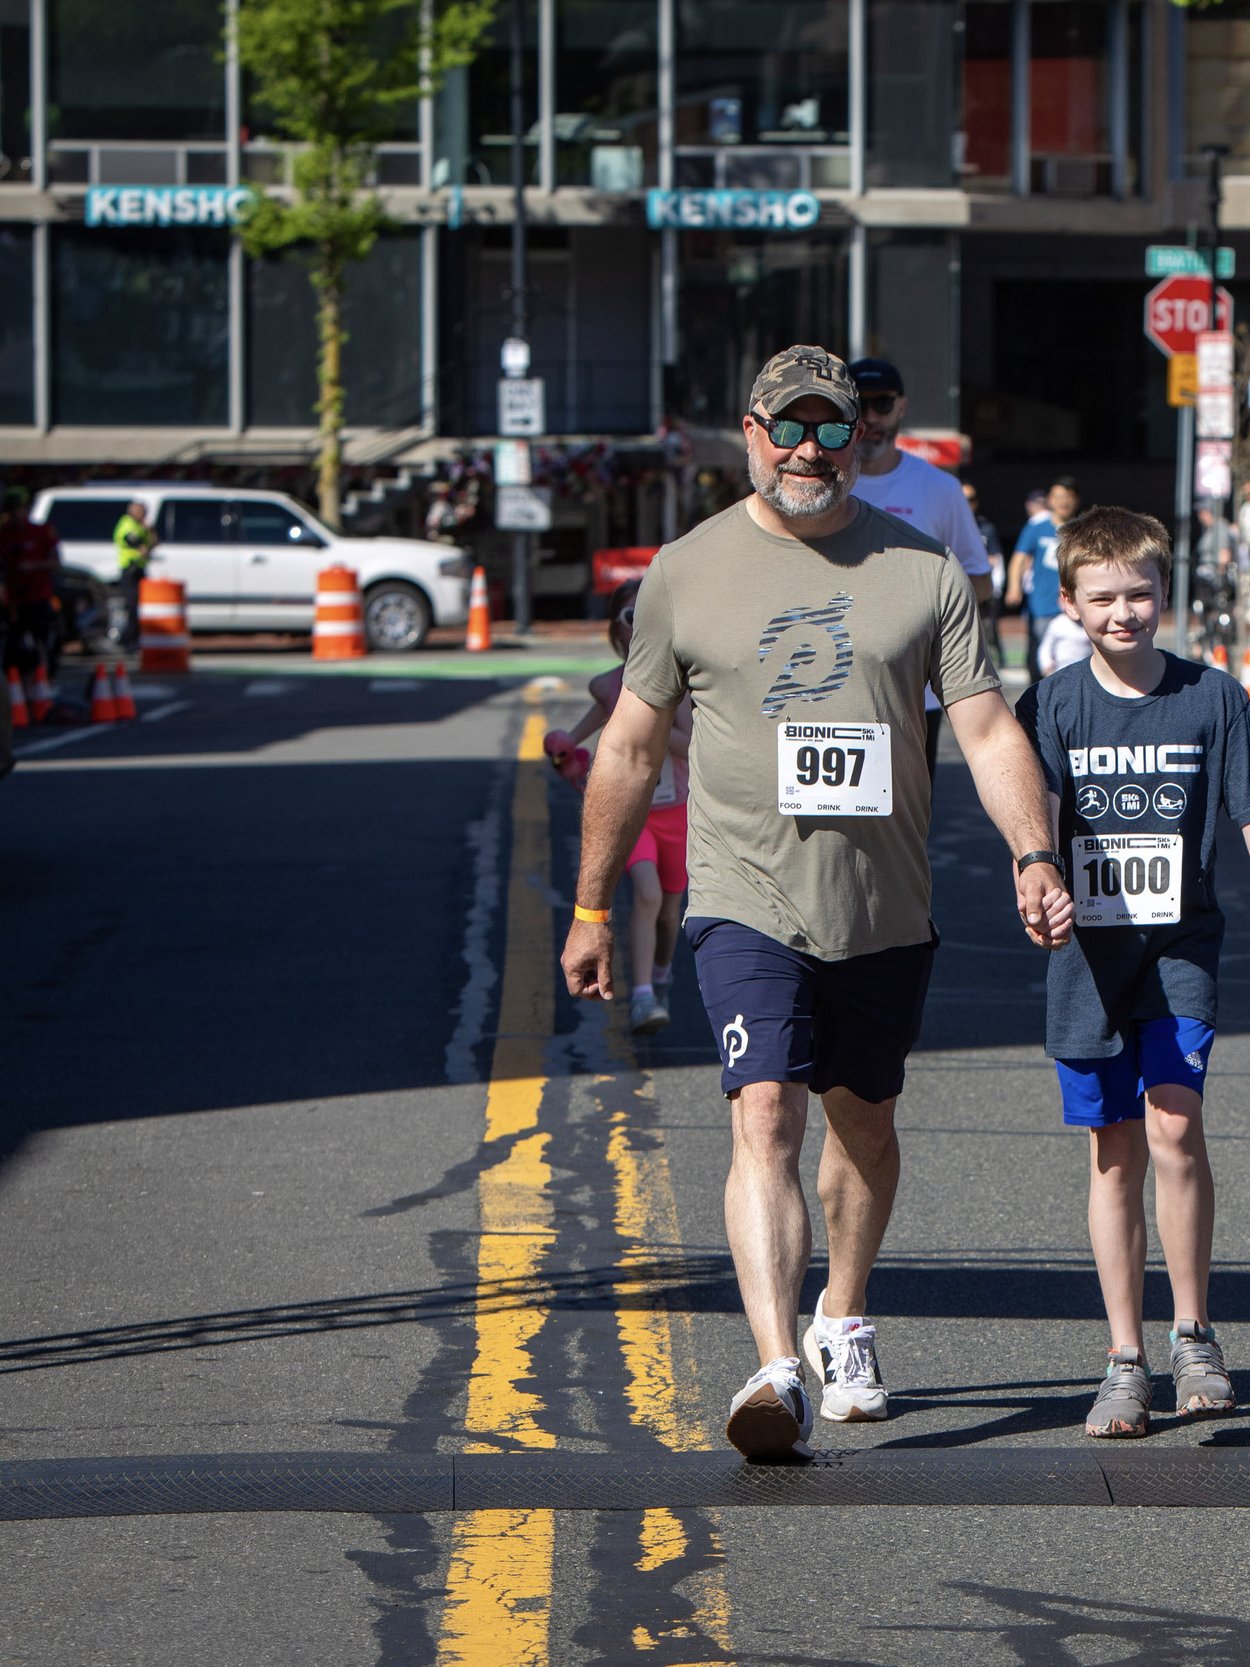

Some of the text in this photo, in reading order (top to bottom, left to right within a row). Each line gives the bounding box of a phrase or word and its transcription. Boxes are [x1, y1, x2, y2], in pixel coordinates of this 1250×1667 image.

[655, 192, 818, 227] KENSHO
[786, 725, 862, 740] BIONIC
[796, 746, 866, 787] 997
[1069, 744, 1203, 777] BIONIC
[780, 802, 802, 810] FOOD
[1084, 837, 1157, 850] BIONIC
[1083, 856, 1170, 897] 1000
[1151, 911, 1174, 919] DRINK
